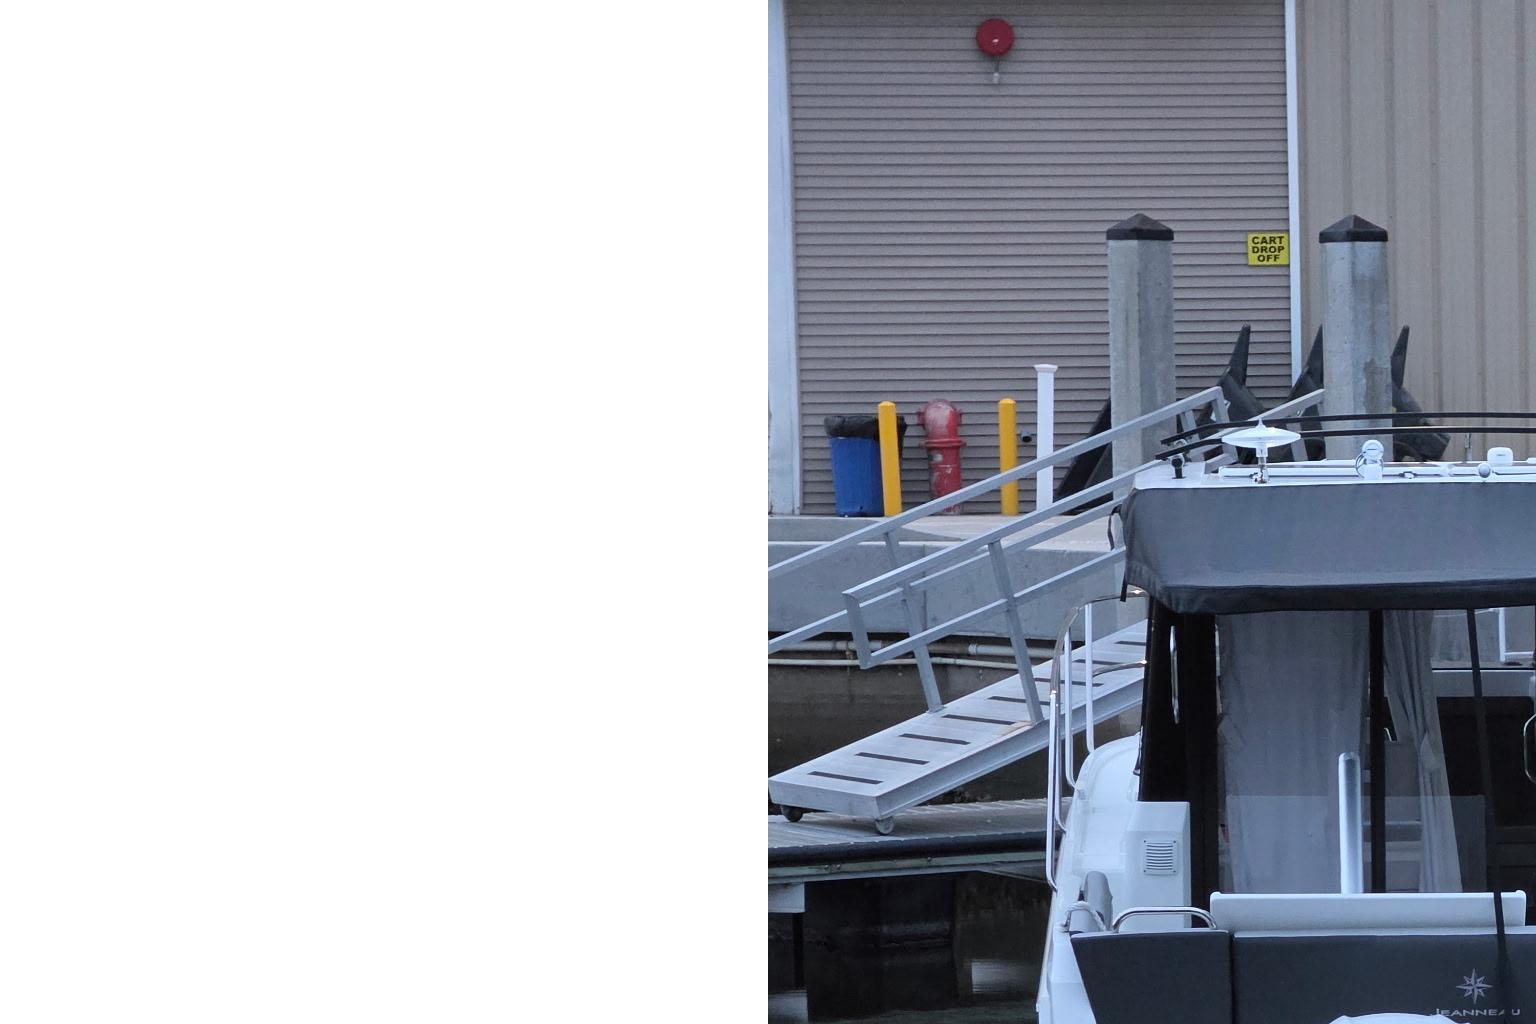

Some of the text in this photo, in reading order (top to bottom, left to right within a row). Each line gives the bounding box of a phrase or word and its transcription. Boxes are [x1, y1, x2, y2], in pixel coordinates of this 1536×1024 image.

[1251, 235, 1285, 245] CART
[1251, 245, 1285, 254] DROP
[1257, 254, 1280, 262] OFF
